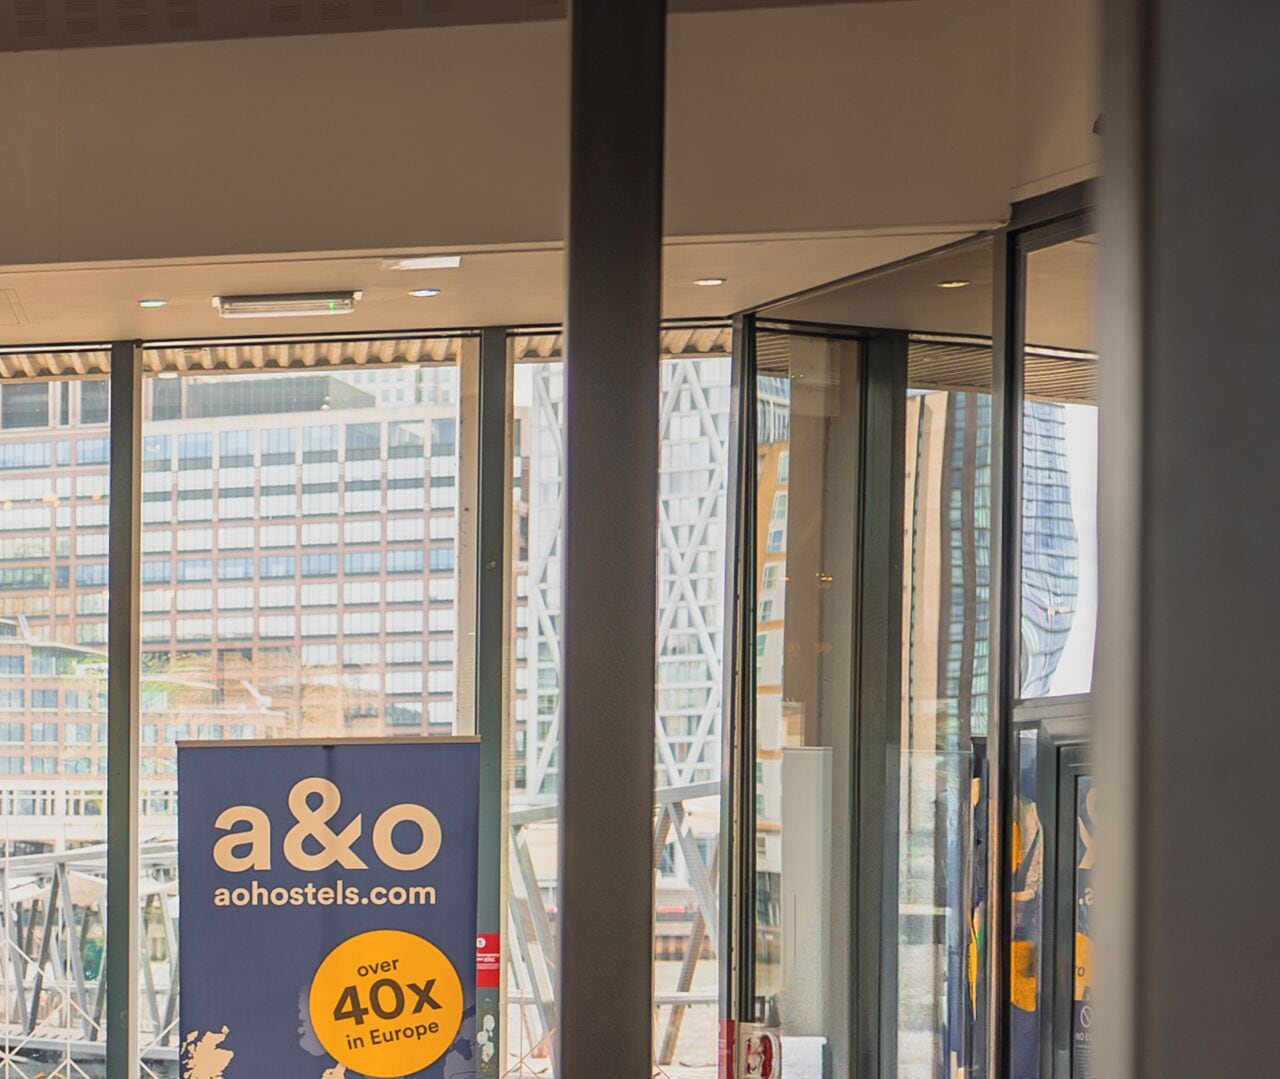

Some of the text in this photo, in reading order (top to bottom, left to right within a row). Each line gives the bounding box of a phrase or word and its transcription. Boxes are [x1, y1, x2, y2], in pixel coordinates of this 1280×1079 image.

[212, 777, 442, 873] a&o
[214, 880, 436, 906] aohostels.com
[357, 959, 399, 977] over
[333, 978, 443, 1026] 40x
[345, 1022, 439, 1050] in Europe
